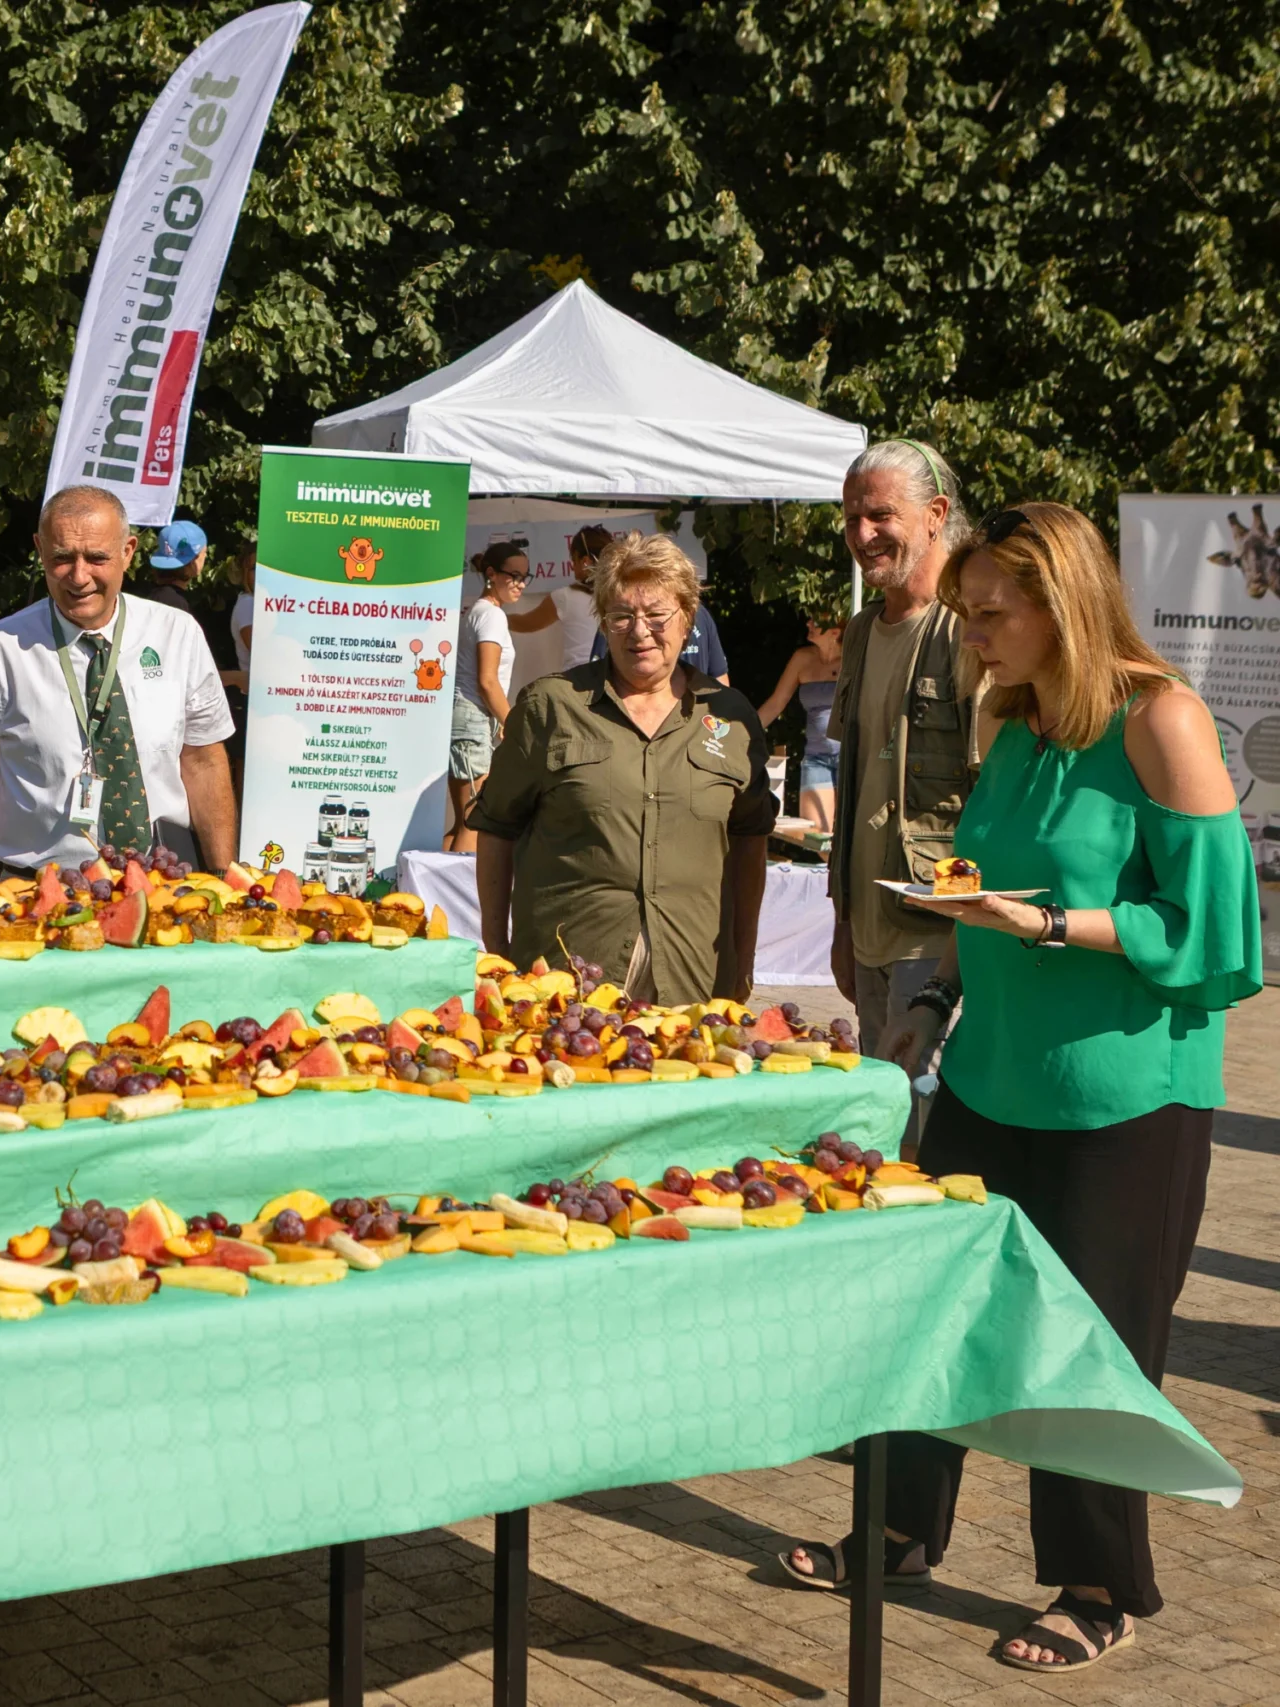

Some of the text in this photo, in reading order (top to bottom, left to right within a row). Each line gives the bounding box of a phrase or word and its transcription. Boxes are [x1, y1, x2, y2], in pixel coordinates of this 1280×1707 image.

[82, 71, 240, 483] immunovet
[85, 101, 193, 454] Animal Health Naturally
[147, 425, 173, 478] Pets
[297, 481, 432, 508] immunovet
[285, 510, 339, 525] TESZTELD
[342, 514, 357, 526] AZ
[535, 561, 556, 579] AZ
[264, 594, 296, 613] KVÍZ
[307, 597, 350, 616] CÉLBA
[353, 600, 388, 618] DOBÓ
[391, 602, 447, 622] KIHÍVÁS!
[310, 636, 397, 649] GYERE, TEDD PRÓBÁRA
[303, 649, 403, 664] TUDÁSOD ÉS ÜGYESSÉGED!
[1218, 657, 1280, 668] TARTALMAZ
[308, 674, 336, 684] TÖLTSD
[336, 676, 345, 685] KI
[346, 677, 352, 685] A
[353, 677, 380, 686] VICCES
[381, 677, 405, 688] KVÍZT!
[267, 687, 437, 704] 2. MINDEN JÓ VÁLASZÉRT KAPSZ EGY LABDÁT!
[296, 703, 407, 717] 3. DOBD LE AZ IMMUNTORNYOT!
[332, 725, 372, 735] SIKERÜLT?
[305, 736, 387, 750] VÁLASSZ AJÁNDÉKOT!
[302, 752, 319, 761] NEM
[320, 753, 360, 763] SIKERÜLT?
[288, 765, 398, 780] MINDENKÉPP RÉSZT VEHETSZ
[291, 780, 396, 793] A NYEREMÉNYSORSOLÁSON!
